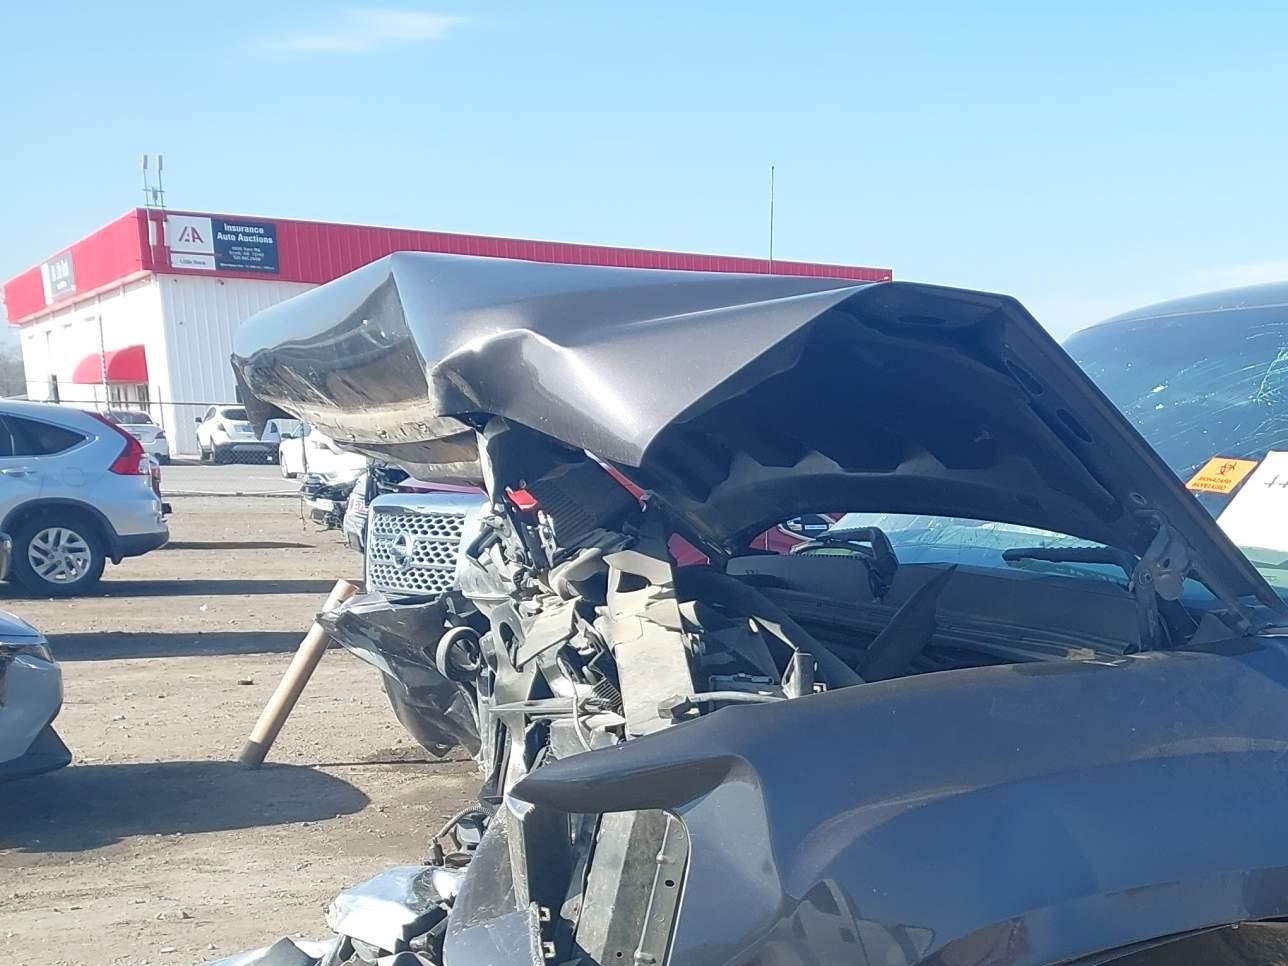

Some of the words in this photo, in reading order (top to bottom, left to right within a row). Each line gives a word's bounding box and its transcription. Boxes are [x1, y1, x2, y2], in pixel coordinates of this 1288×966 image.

[224, 223, 265, 234] Insurance
[217, 232, 236, 242] Auto
[238, 233, 274, 244] Auctions
